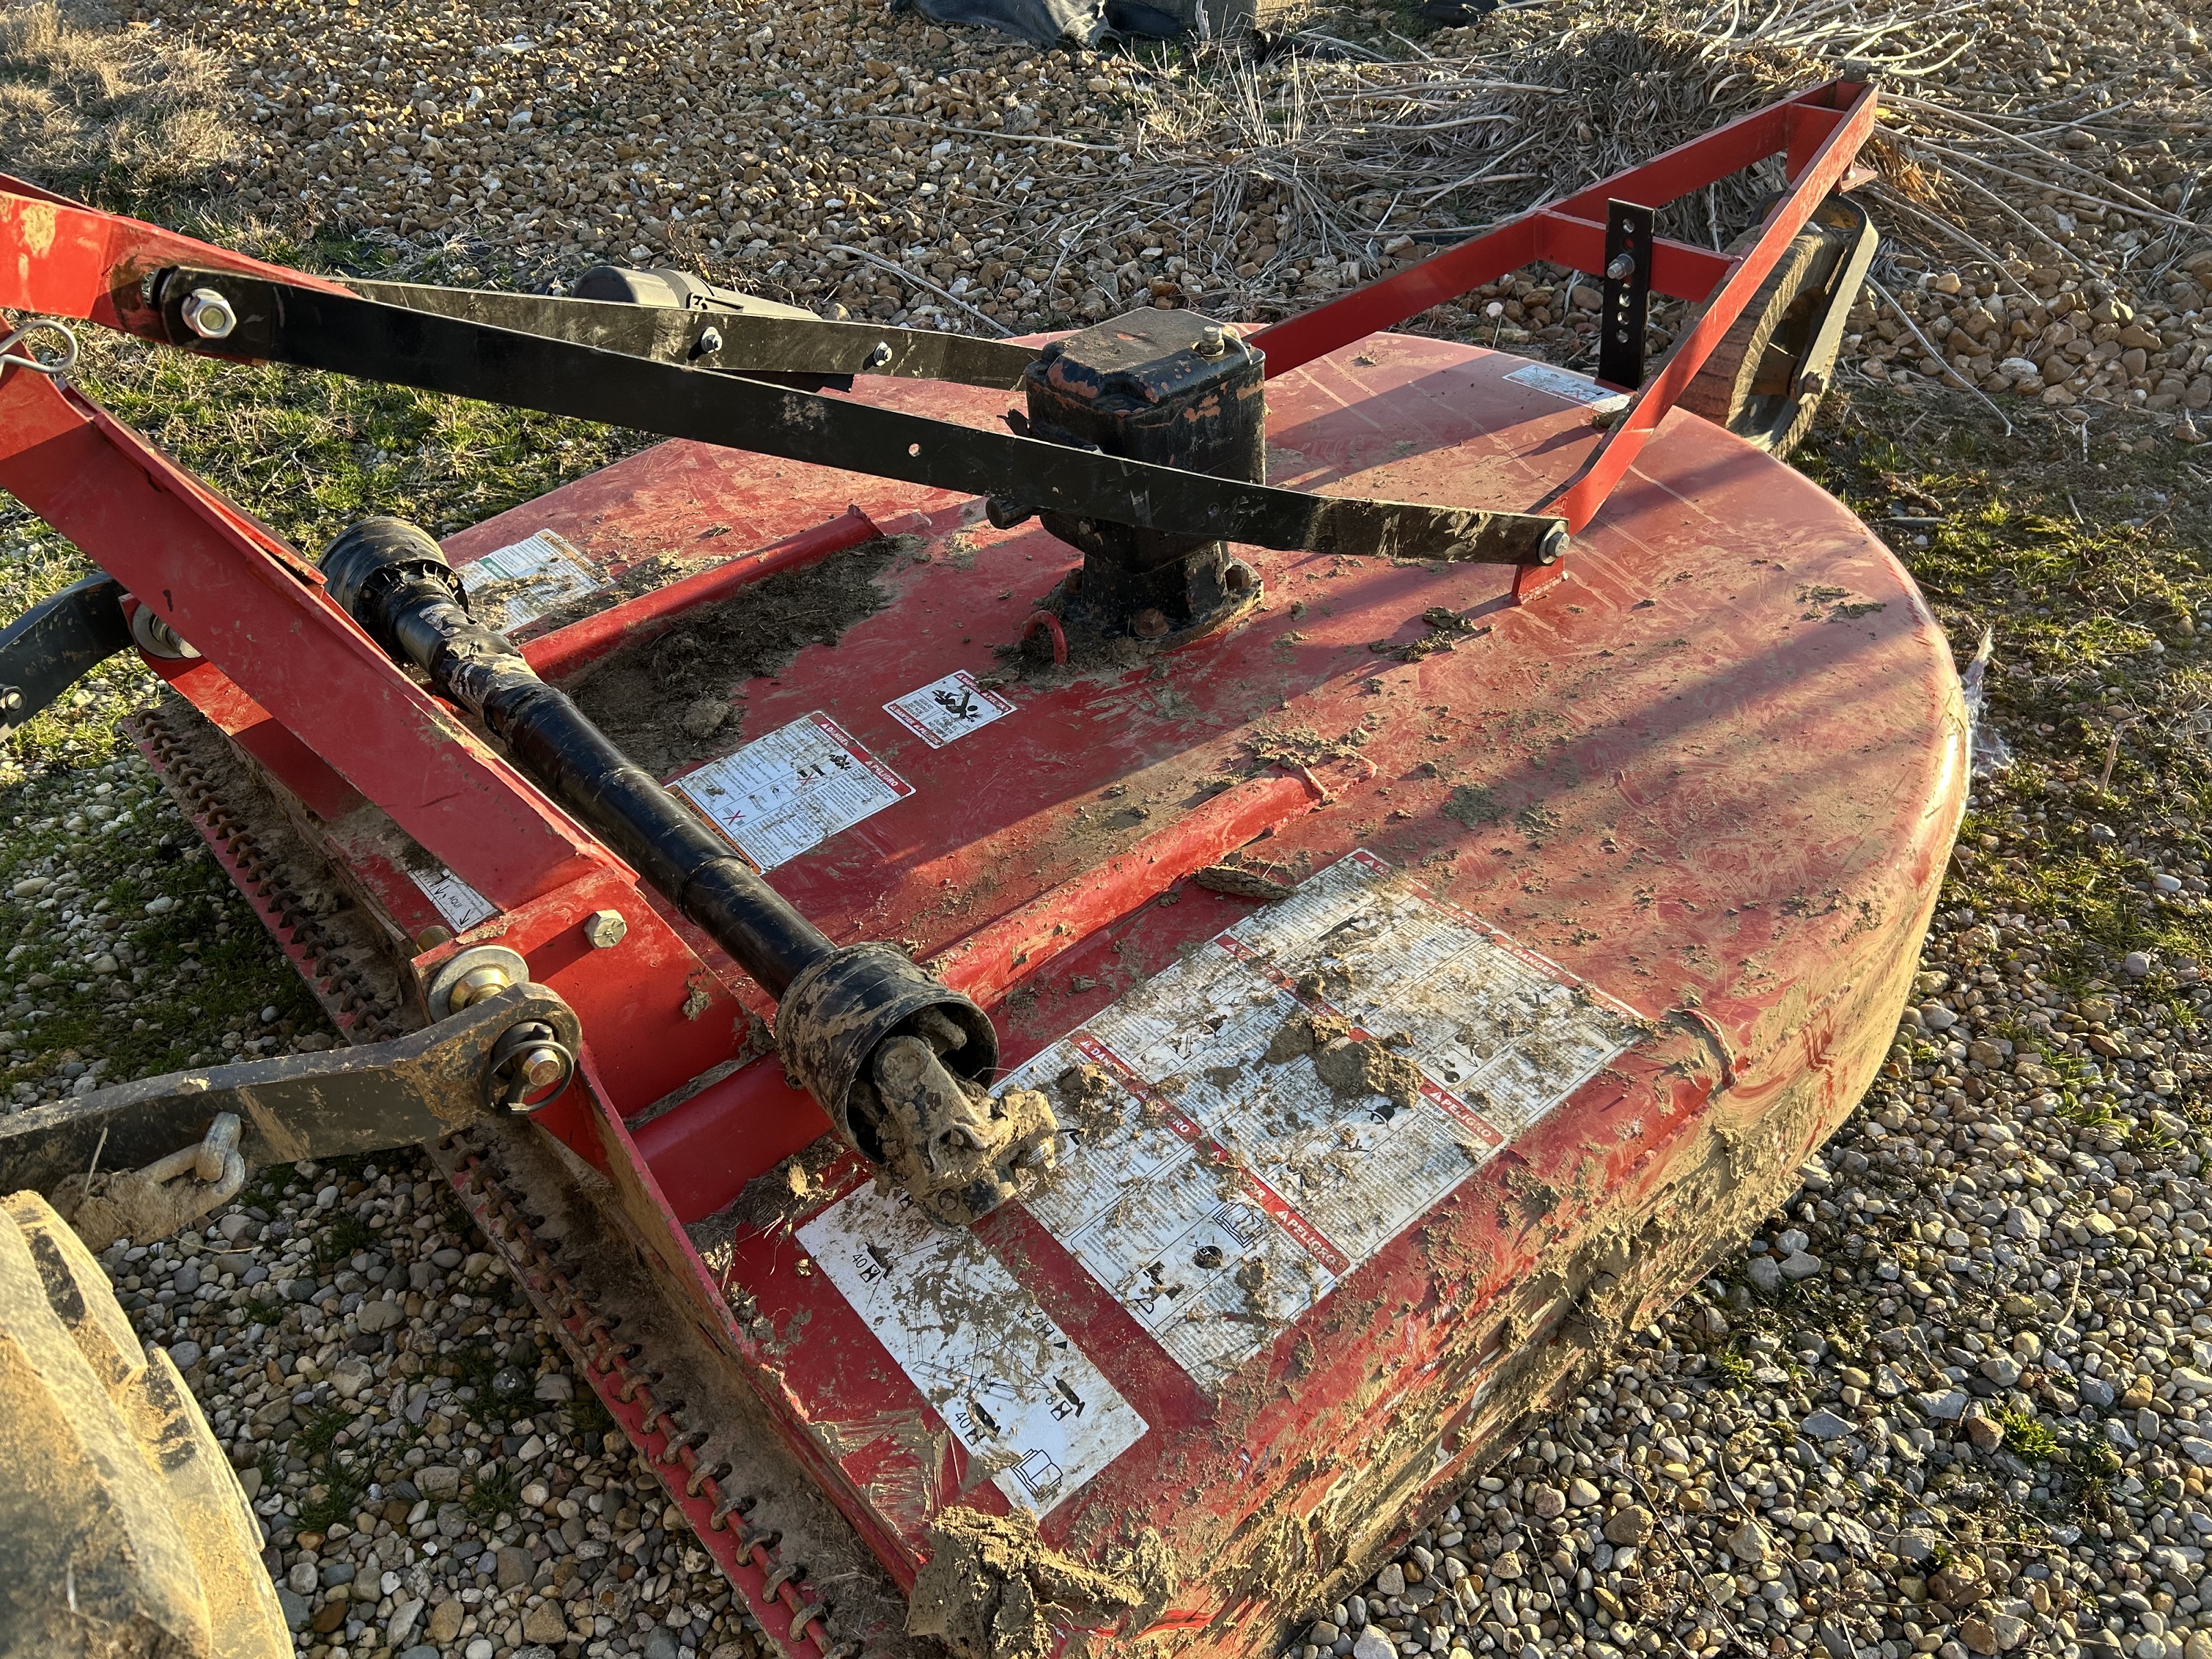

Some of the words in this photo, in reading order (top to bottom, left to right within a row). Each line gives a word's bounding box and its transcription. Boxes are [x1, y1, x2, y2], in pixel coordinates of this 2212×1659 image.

[1500, 951, 1517, 962] KEEP
[1515, 960, 1534, 972] AWAY
[1513, 949, 1559, 977] DANGER
[1439, 1098, 1494, 1139] PELIGRO
[1155, 1209, 1173, 1226] DEALER
[1131, 1242, 1144, 1255] safety
[1285, 1218, 1338, 1265] PELIGRO
[852, 1254, 867, 1268] 40
[1086, 1235, 1103, 1252] protection
[1101, 1250, 1113, 1261] when
[1109, 1258, 1127, 1276] operating
[1031, 1318, 1043, 1328] 8
[954, 1412, 971, 1429] 40
